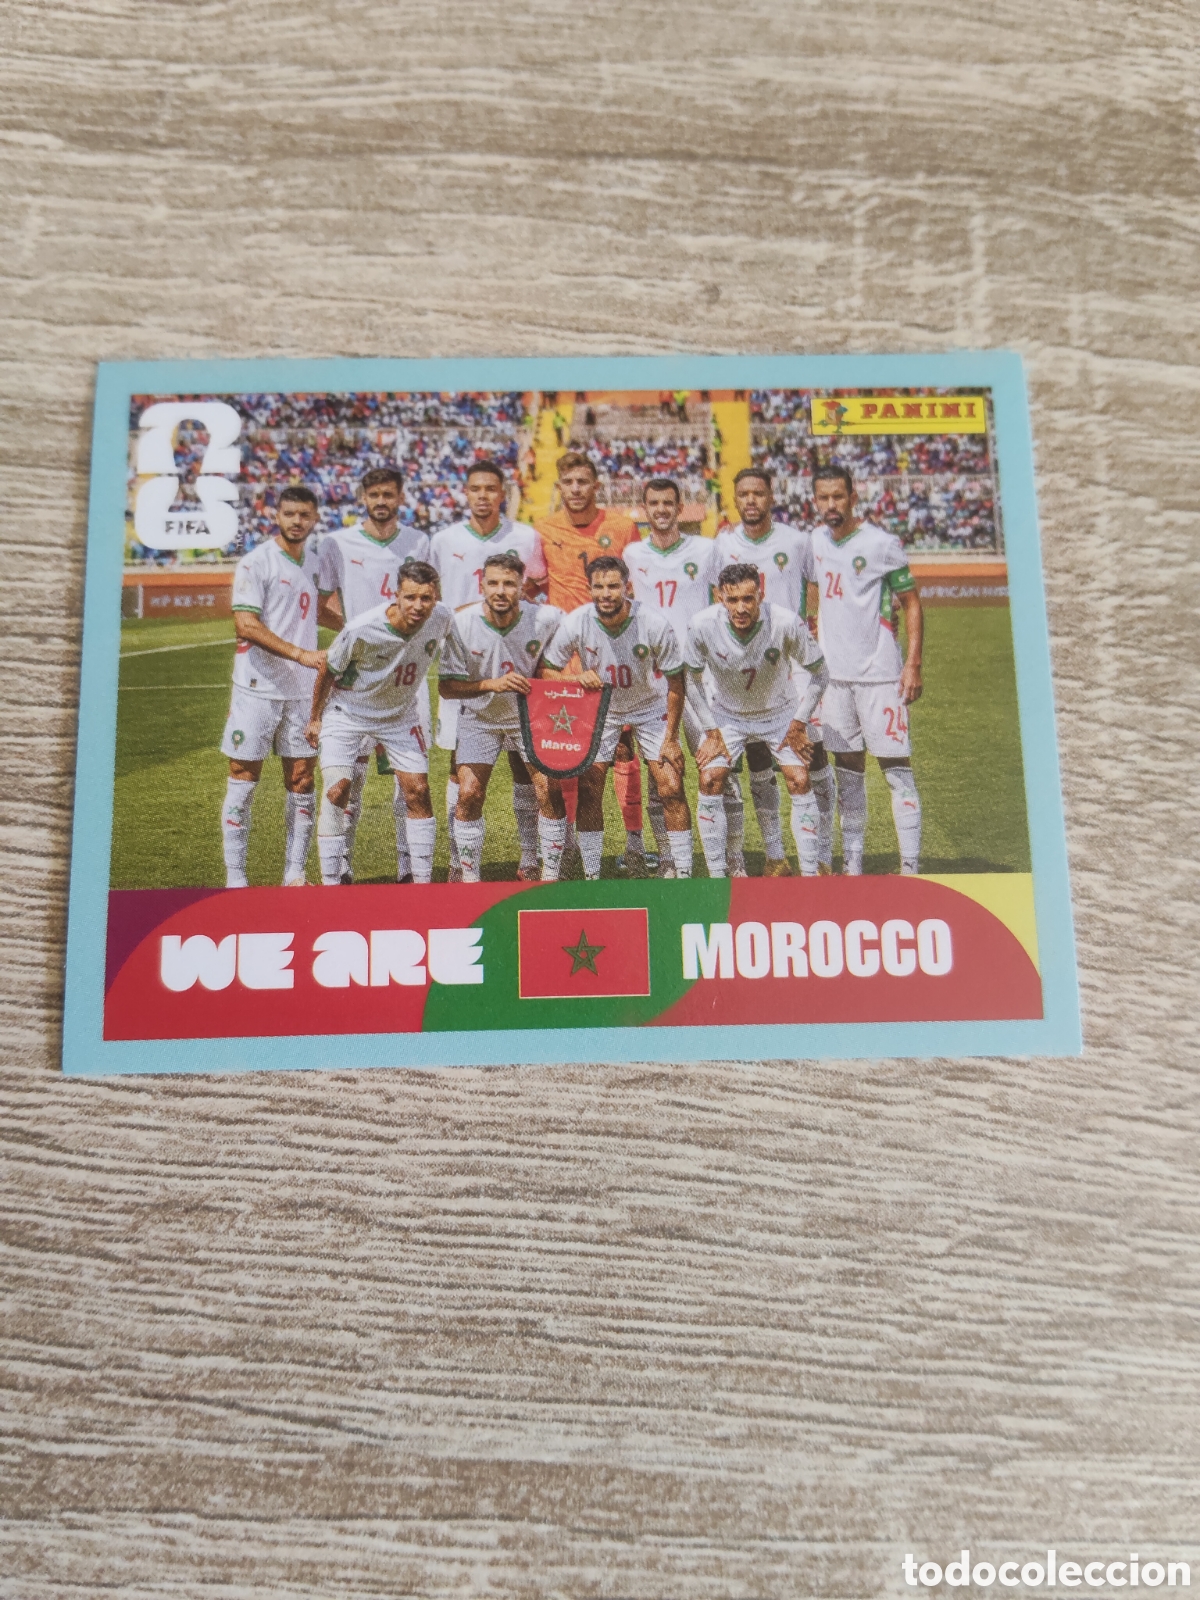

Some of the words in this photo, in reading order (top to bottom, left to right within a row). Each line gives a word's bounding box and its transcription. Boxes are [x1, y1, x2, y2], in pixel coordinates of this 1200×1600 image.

[860, 402, 976, 419] PANINI
[164, 521, 211, 535] FIFA
[380, 572, 397, 600] 4
[655, 580, 677, 608] 17
[825, 571, 843, 600] 24
[299, 591, 311, 620] 9
[394, 662, 417, 687] 18
[605, 663, 633, 689] 10
[741, 667, 757, 690] 7
[883, 705, 908, 737] 24
[541, 739, 581, 751] Maroc
[160, 932, 295, 991] WE
[312, 927, 484, 987] ARE
[681, 918, 953, 980] MOROCCO
